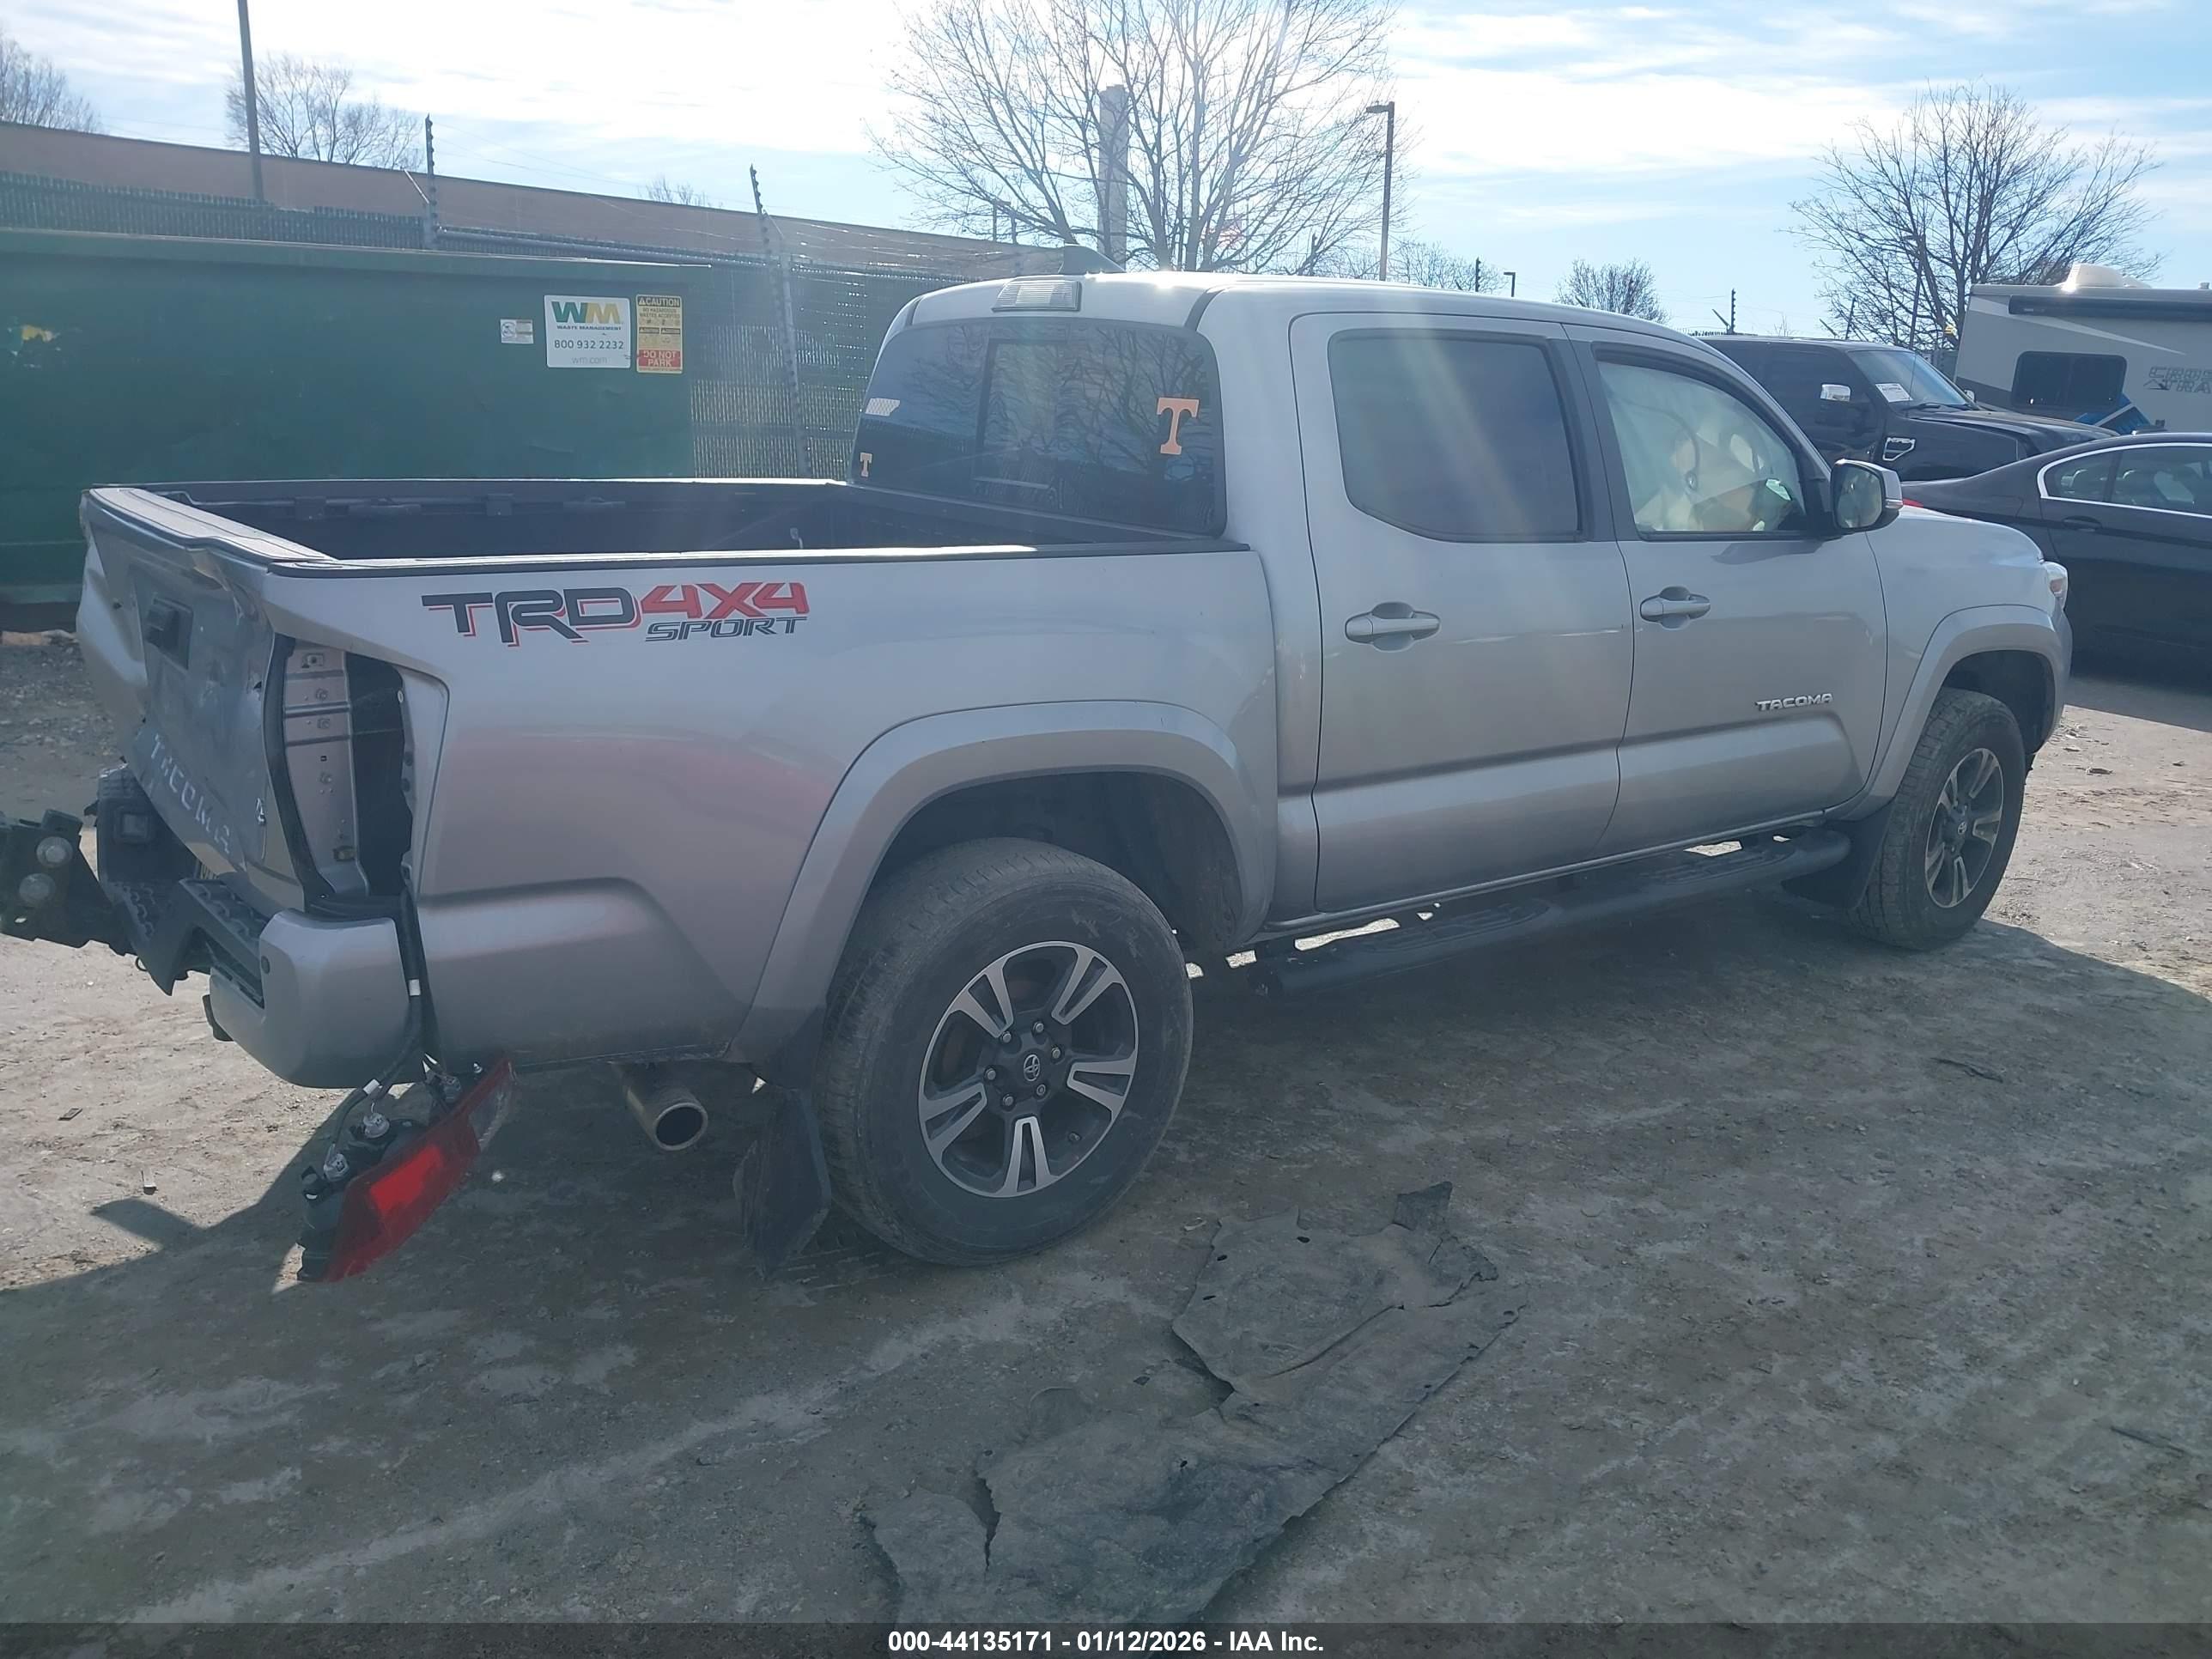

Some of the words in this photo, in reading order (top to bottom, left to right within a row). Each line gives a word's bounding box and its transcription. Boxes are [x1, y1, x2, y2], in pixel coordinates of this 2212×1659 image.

[551, 301, 620, 324] WM
[645, 297, 679, 307] CAUTION
[554, 339, 574, 349] 800
[576, 340, 596, 349] 932
[599, 340, 624, 349] 2232
[659, 350, 677, 359] NOT
[647, 358, 672, 368] PARK
[1157, 398, 1200, 455] T
[860, 453, 873, 477] T
[421, 586, 642, 647] TRD
[645, 616, 808, 642] SPORT
[1755, 692, 1833, 711] TACOMA
